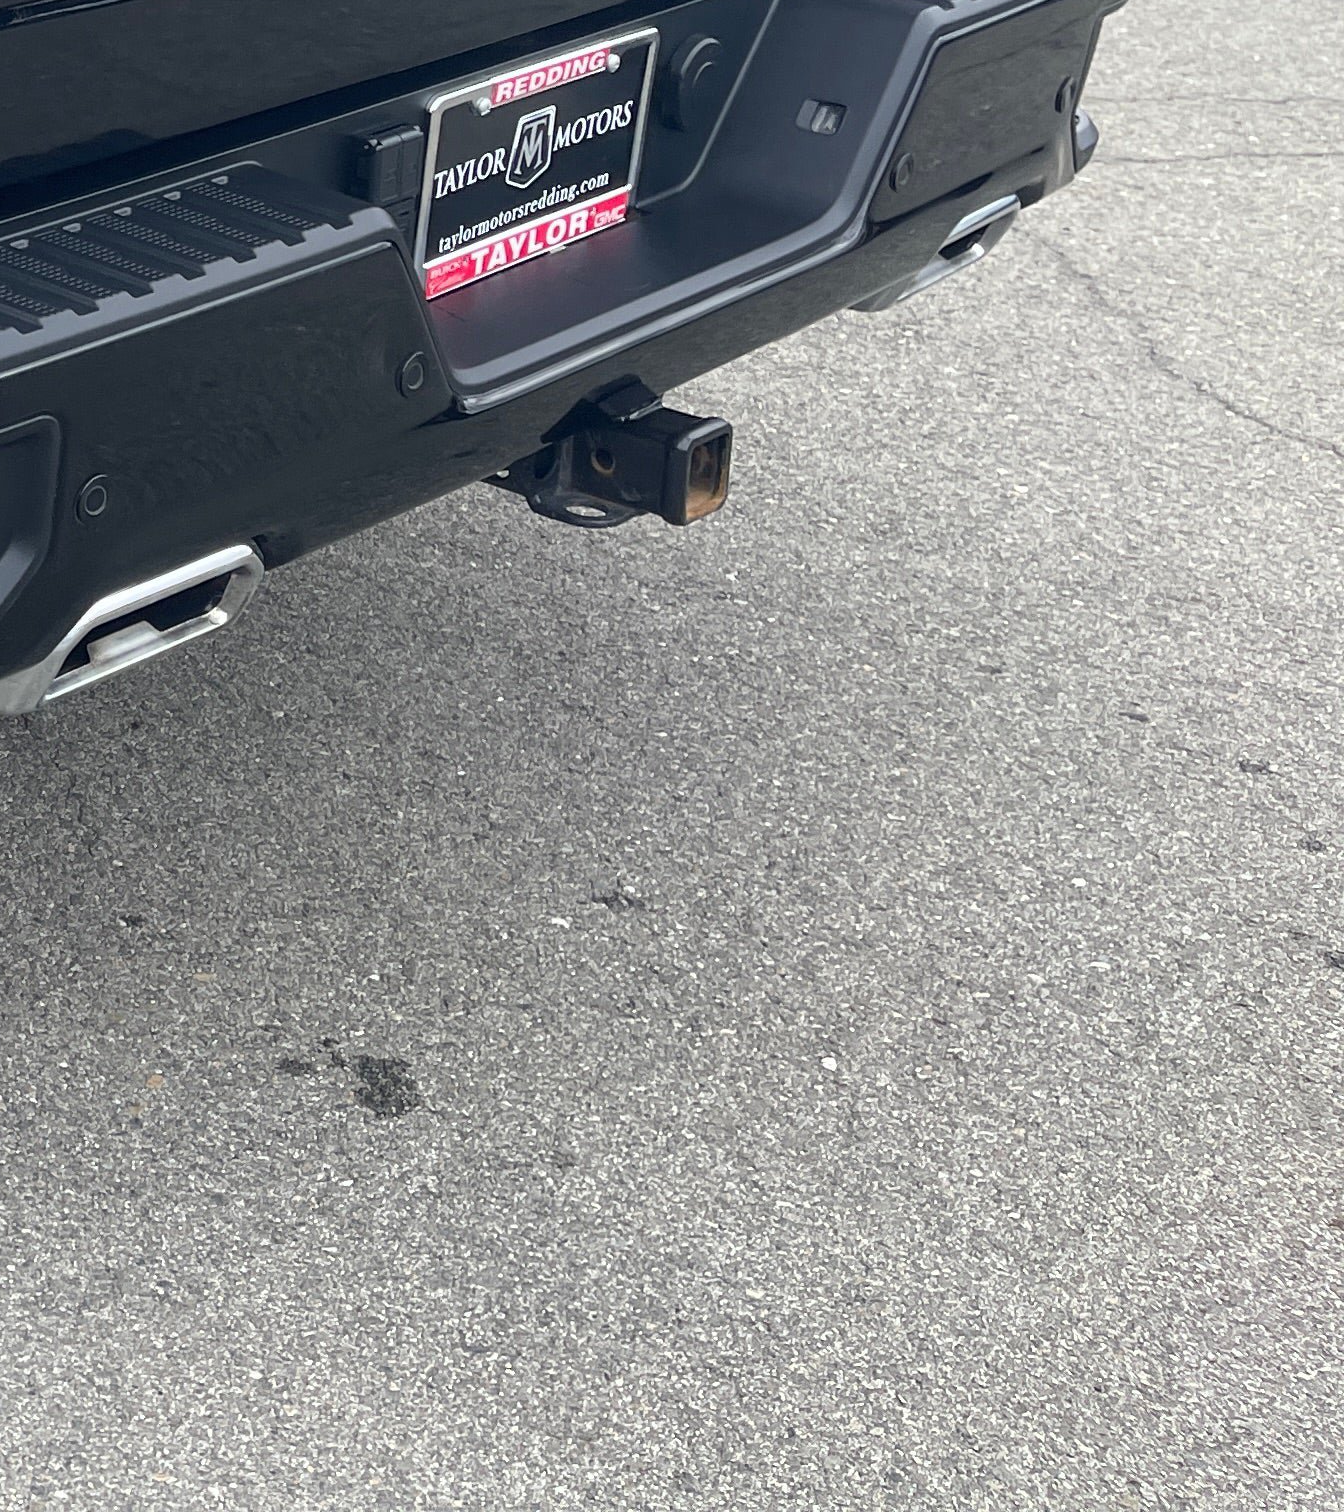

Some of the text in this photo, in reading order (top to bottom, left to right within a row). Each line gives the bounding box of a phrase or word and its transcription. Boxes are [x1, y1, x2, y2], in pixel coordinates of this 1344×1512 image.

[494, 50, 607, 105] REDDING
[434, 147, 506, 199] TAYLOR
[553, 100, 634, 151] MOTORS
[438, 172, 610, 254] taylormotorsredding.com
[470, 210, 588, 276] TAYLOR
[593, 205, 626, 228] GMC
